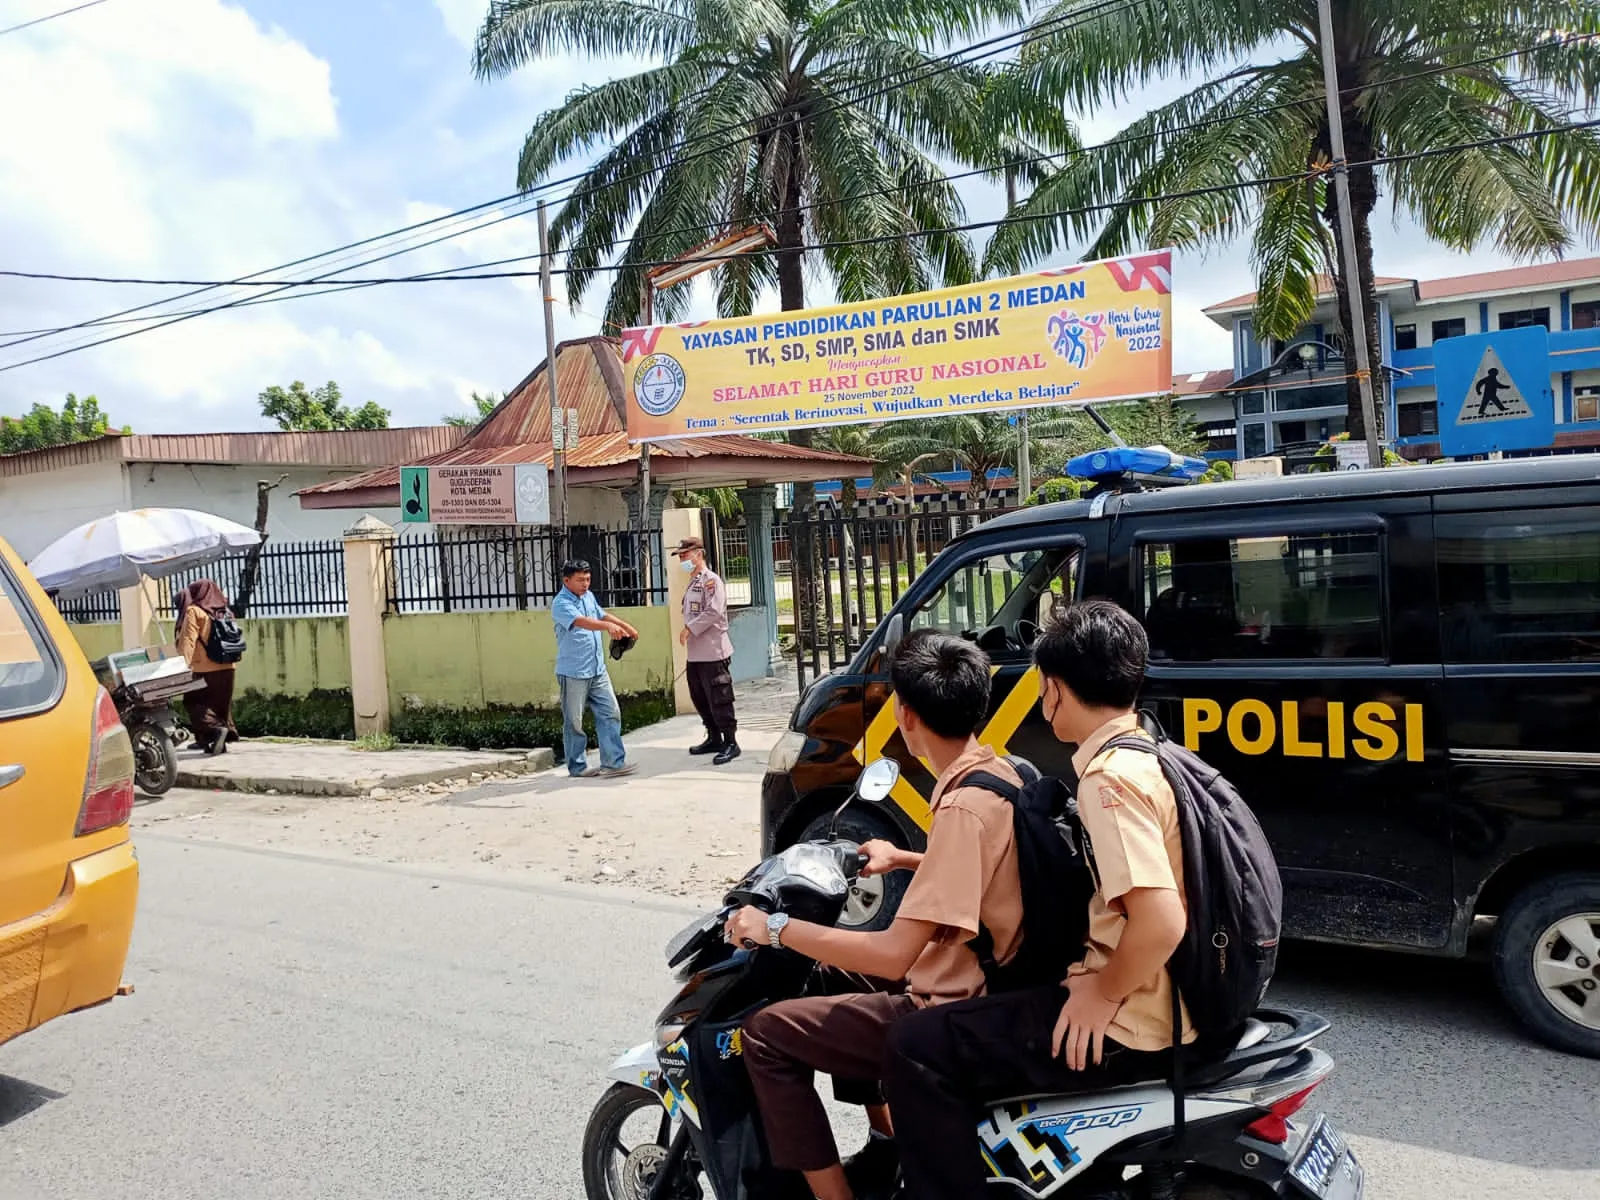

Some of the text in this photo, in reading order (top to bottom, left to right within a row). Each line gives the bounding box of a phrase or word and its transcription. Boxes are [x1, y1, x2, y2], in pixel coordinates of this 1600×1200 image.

[682, 281, 1085, 350] YAYASAN PENDIDIKAN PARULIAN 2 MEDAN
[1108, 306, 1161, 325] Hari Guru
[1116, 319, 1160, 337] Nasional
[745, 317, 1000, 367] TK, SD, SMP, SMA dan SMK
[1129, 335, 1161, 351] 2022
[713, 353, 1047, 402] SELAMAT HARI GURU NASIONAL
[824, 385, 915, 403] 25 November 2022
[687, 418, 717, 429] Tema
[795, 401, 868, 420] Berinovasi,
[873, 397, 943, 414] Wujudkan
[949, 388, 1013, 406] Merdeka
[438, 468, 502, 478] GERAKAN PRAMUKA
[469, 486, 491, 495] MEDAN
[1183, 698, 1424, 762] POLISI
[660, 1057, 686, 1066] HONDA
